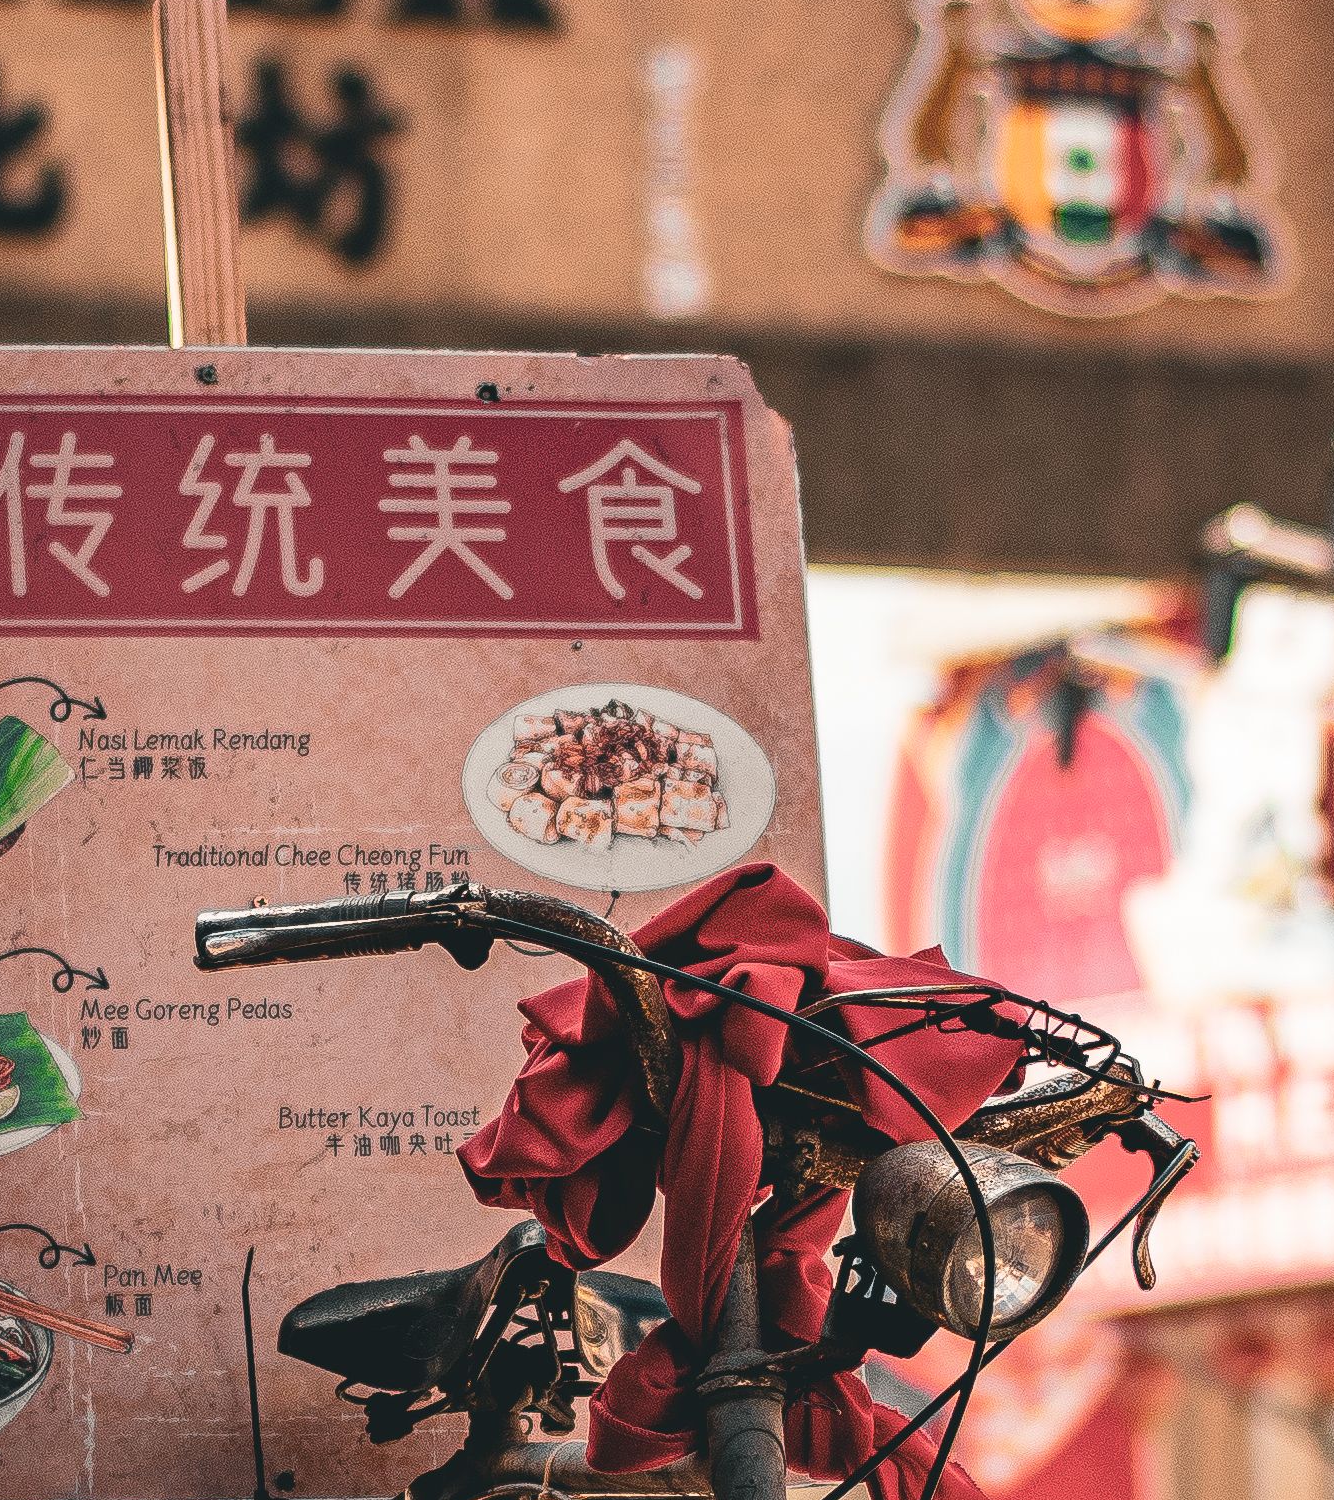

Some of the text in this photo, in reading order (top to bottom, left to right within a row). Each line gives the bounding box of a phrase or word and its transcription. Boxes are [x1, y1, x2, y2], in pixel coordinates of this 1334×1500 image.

[77, 728, 311, 757] Nasi Lemak Rendang
[152, 844, 472, 872] Traditional Chee Cheong Fun
[80, 997, 293, 1027] Mee Goreng Pedas
[81, 1025, 129, 1050] 炒面
[278, 1104, 480, 1135] Butter Kaya Toast
[103, 1263, 203, 1287] Pan Mee
[104, 1293, 153, 1317] 板面
